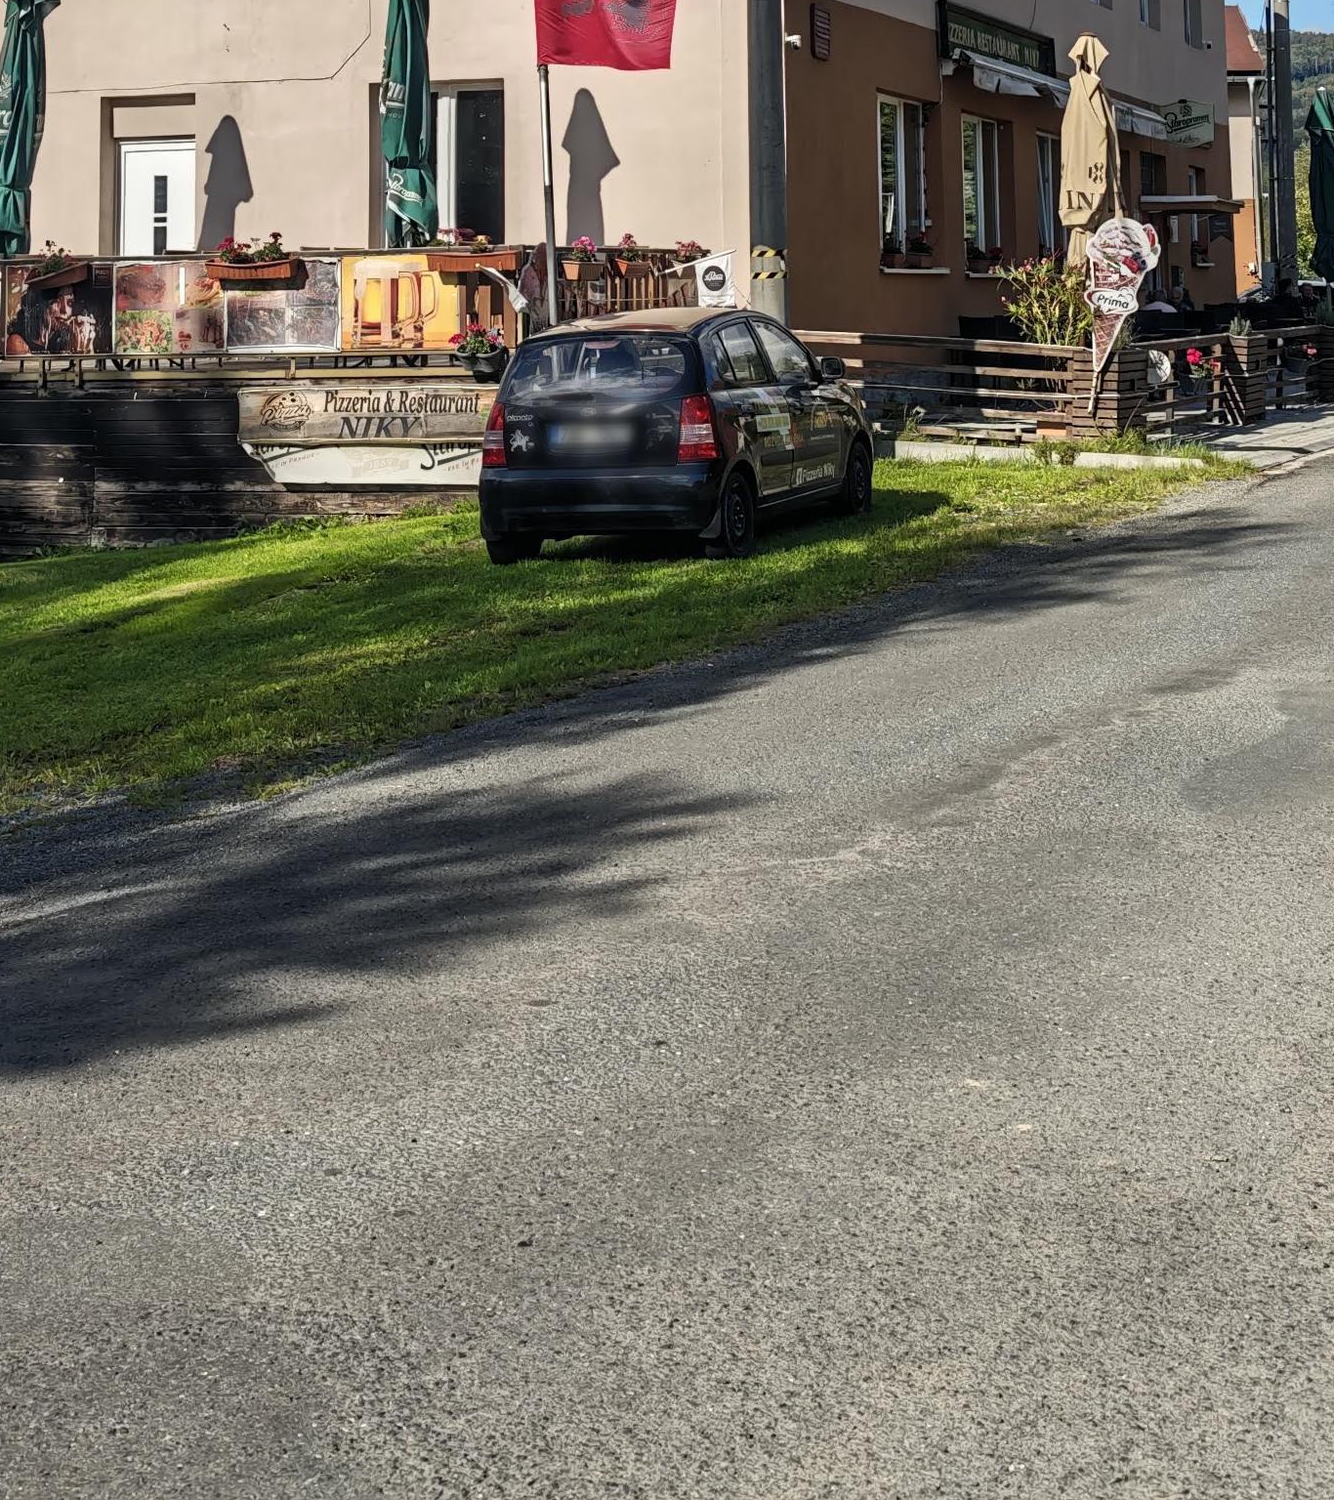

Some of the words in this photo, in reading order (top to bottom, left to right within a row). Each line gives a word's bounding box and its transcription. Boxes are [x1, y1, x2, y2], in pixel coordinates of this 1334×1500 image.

[1097, 295, 1129, 310] Prima
[323, 390, 380, 413] Pizzeria
[384, 391, 397, 413] &
[397, 391, 481, 414] Restaurant
[338, 416, 424, 438] NIKY
